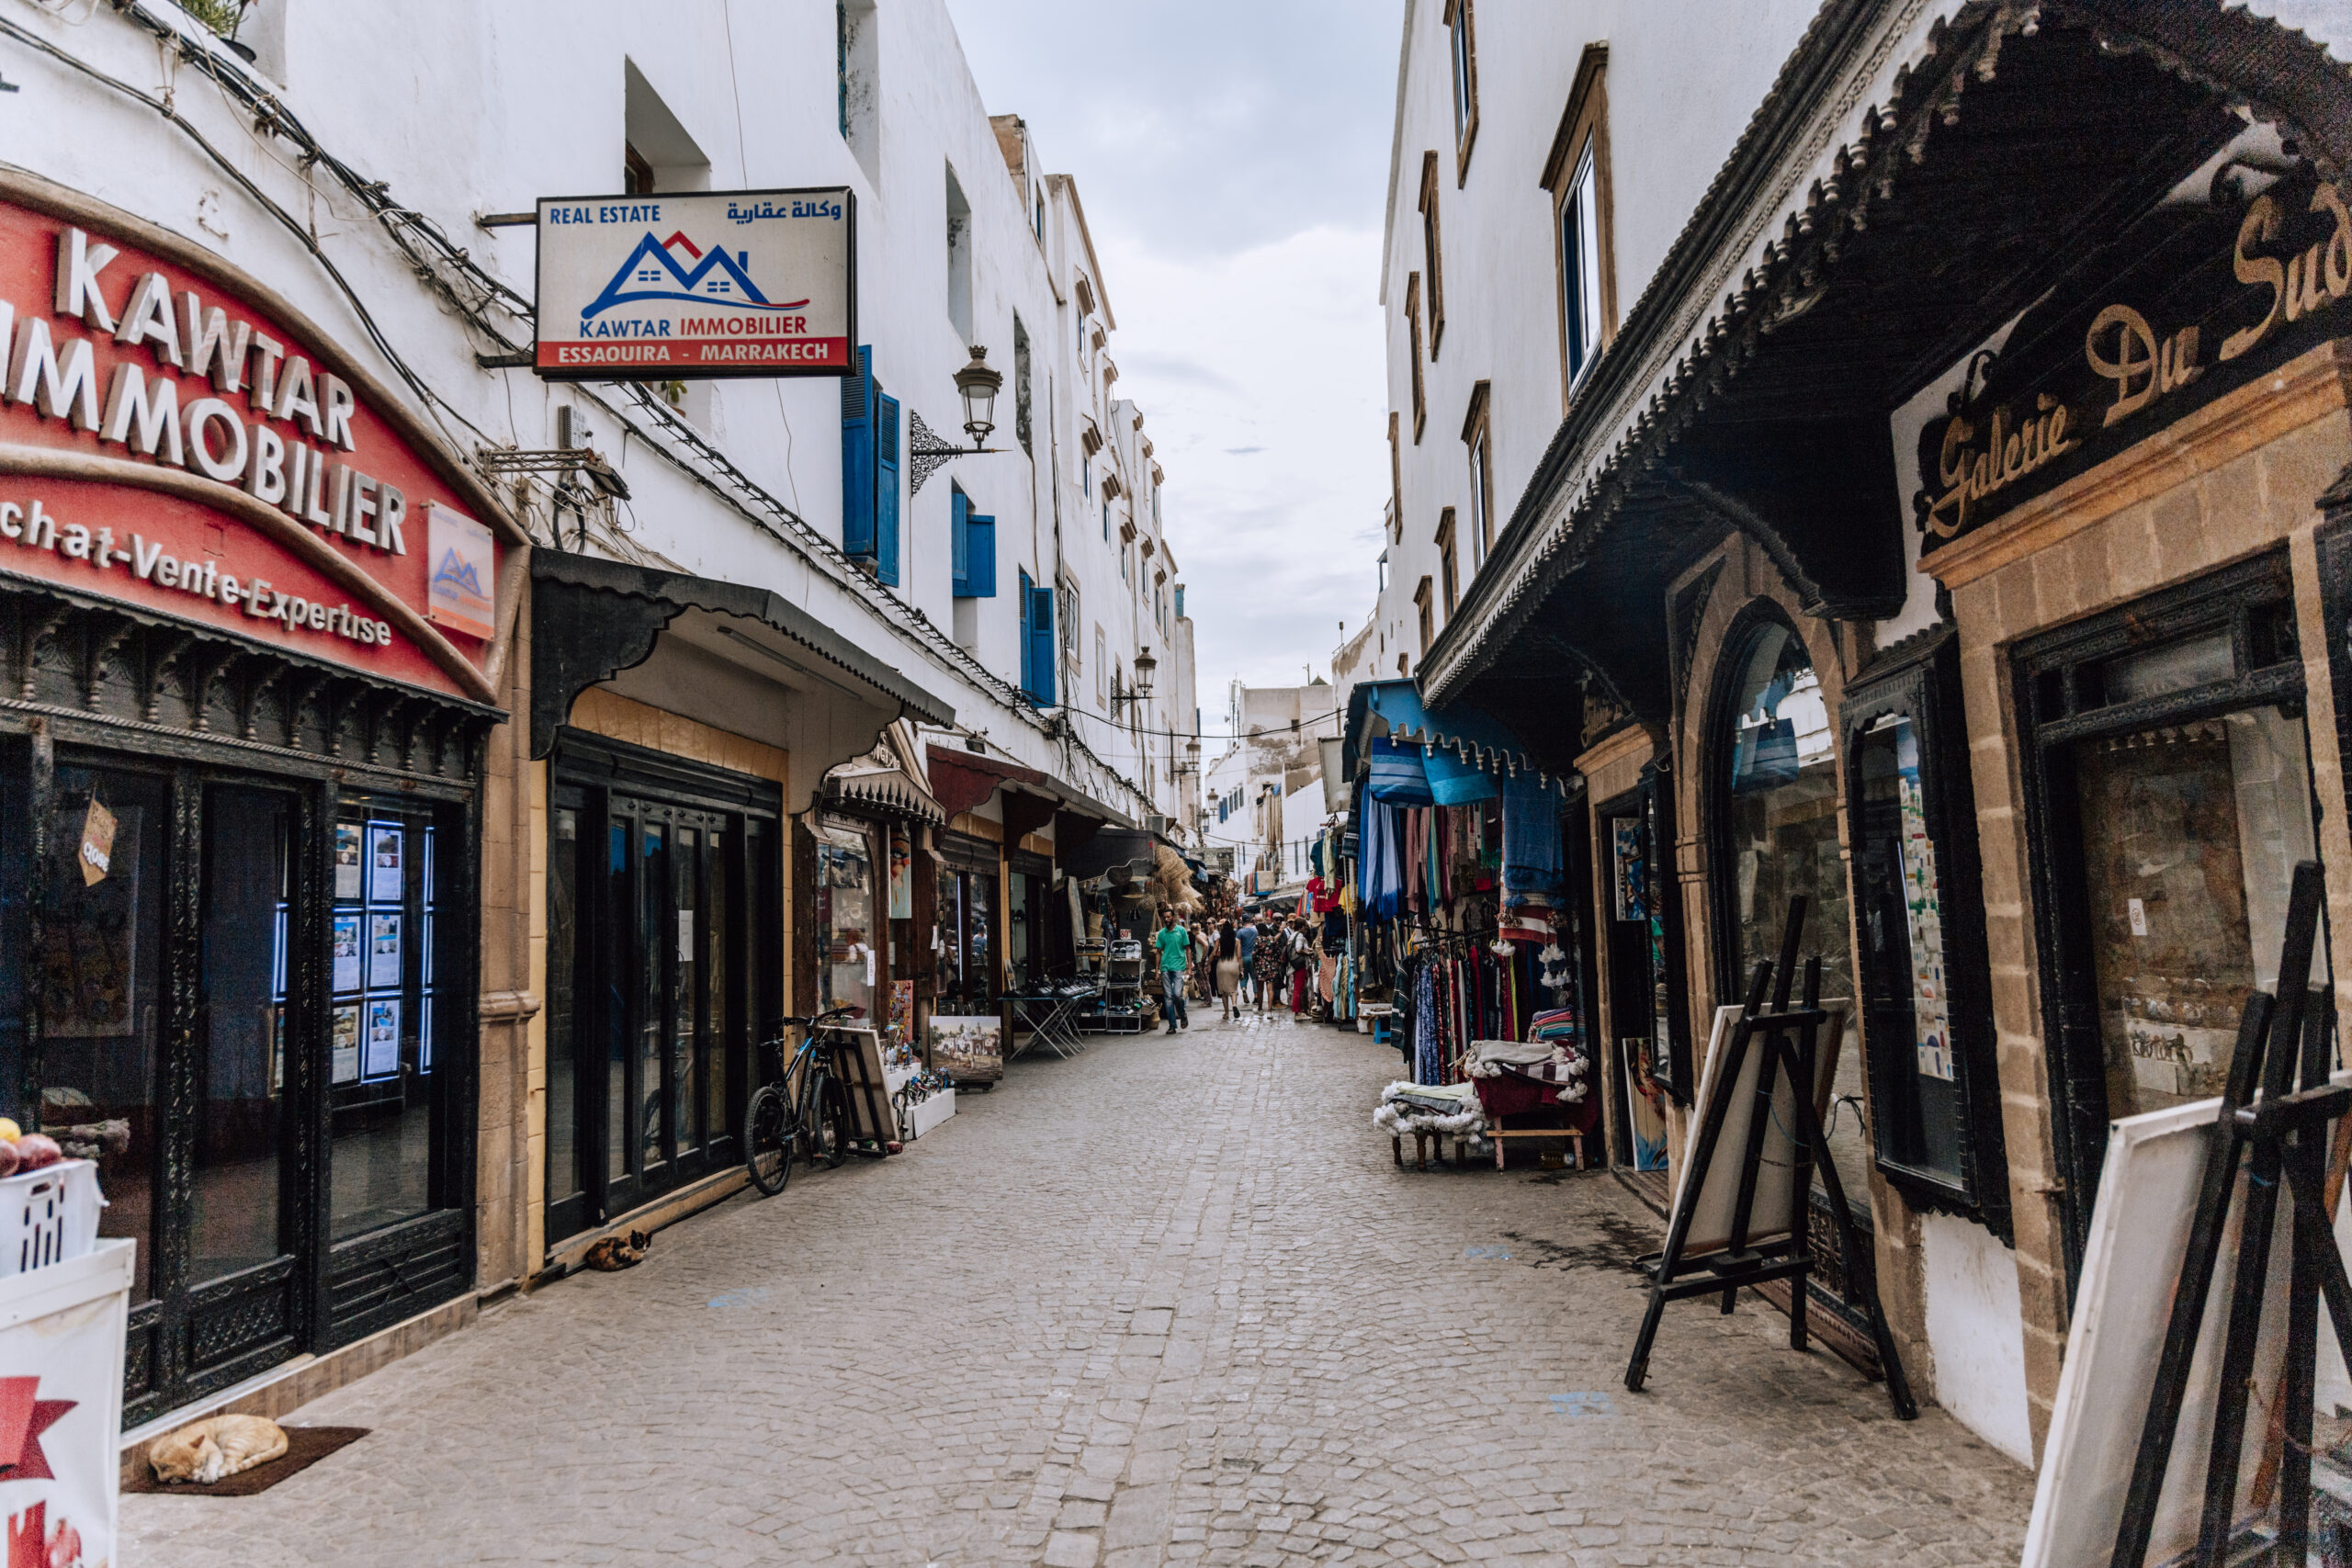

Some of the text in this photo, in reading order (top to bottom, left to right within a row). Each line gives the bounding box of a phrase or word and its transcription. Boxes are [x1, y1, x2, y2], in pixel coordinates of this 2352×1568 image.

[550, 205, 661, 224] REAL ESTATE
[728, 200, 842, 224] وكالة عقارية
[580, 316, 807, 337] KAWTAR IMMOBILIER
[56, 227, 356, 453] KAWTAR
[559, 345, 671, 363] ESSAOUIRA
[700, 343, 828, 361] MARRAKECH
[1929, 184, 2352, 538] Galerie Du Sud
[0, 299, 407, 556] IMMOBILIER
